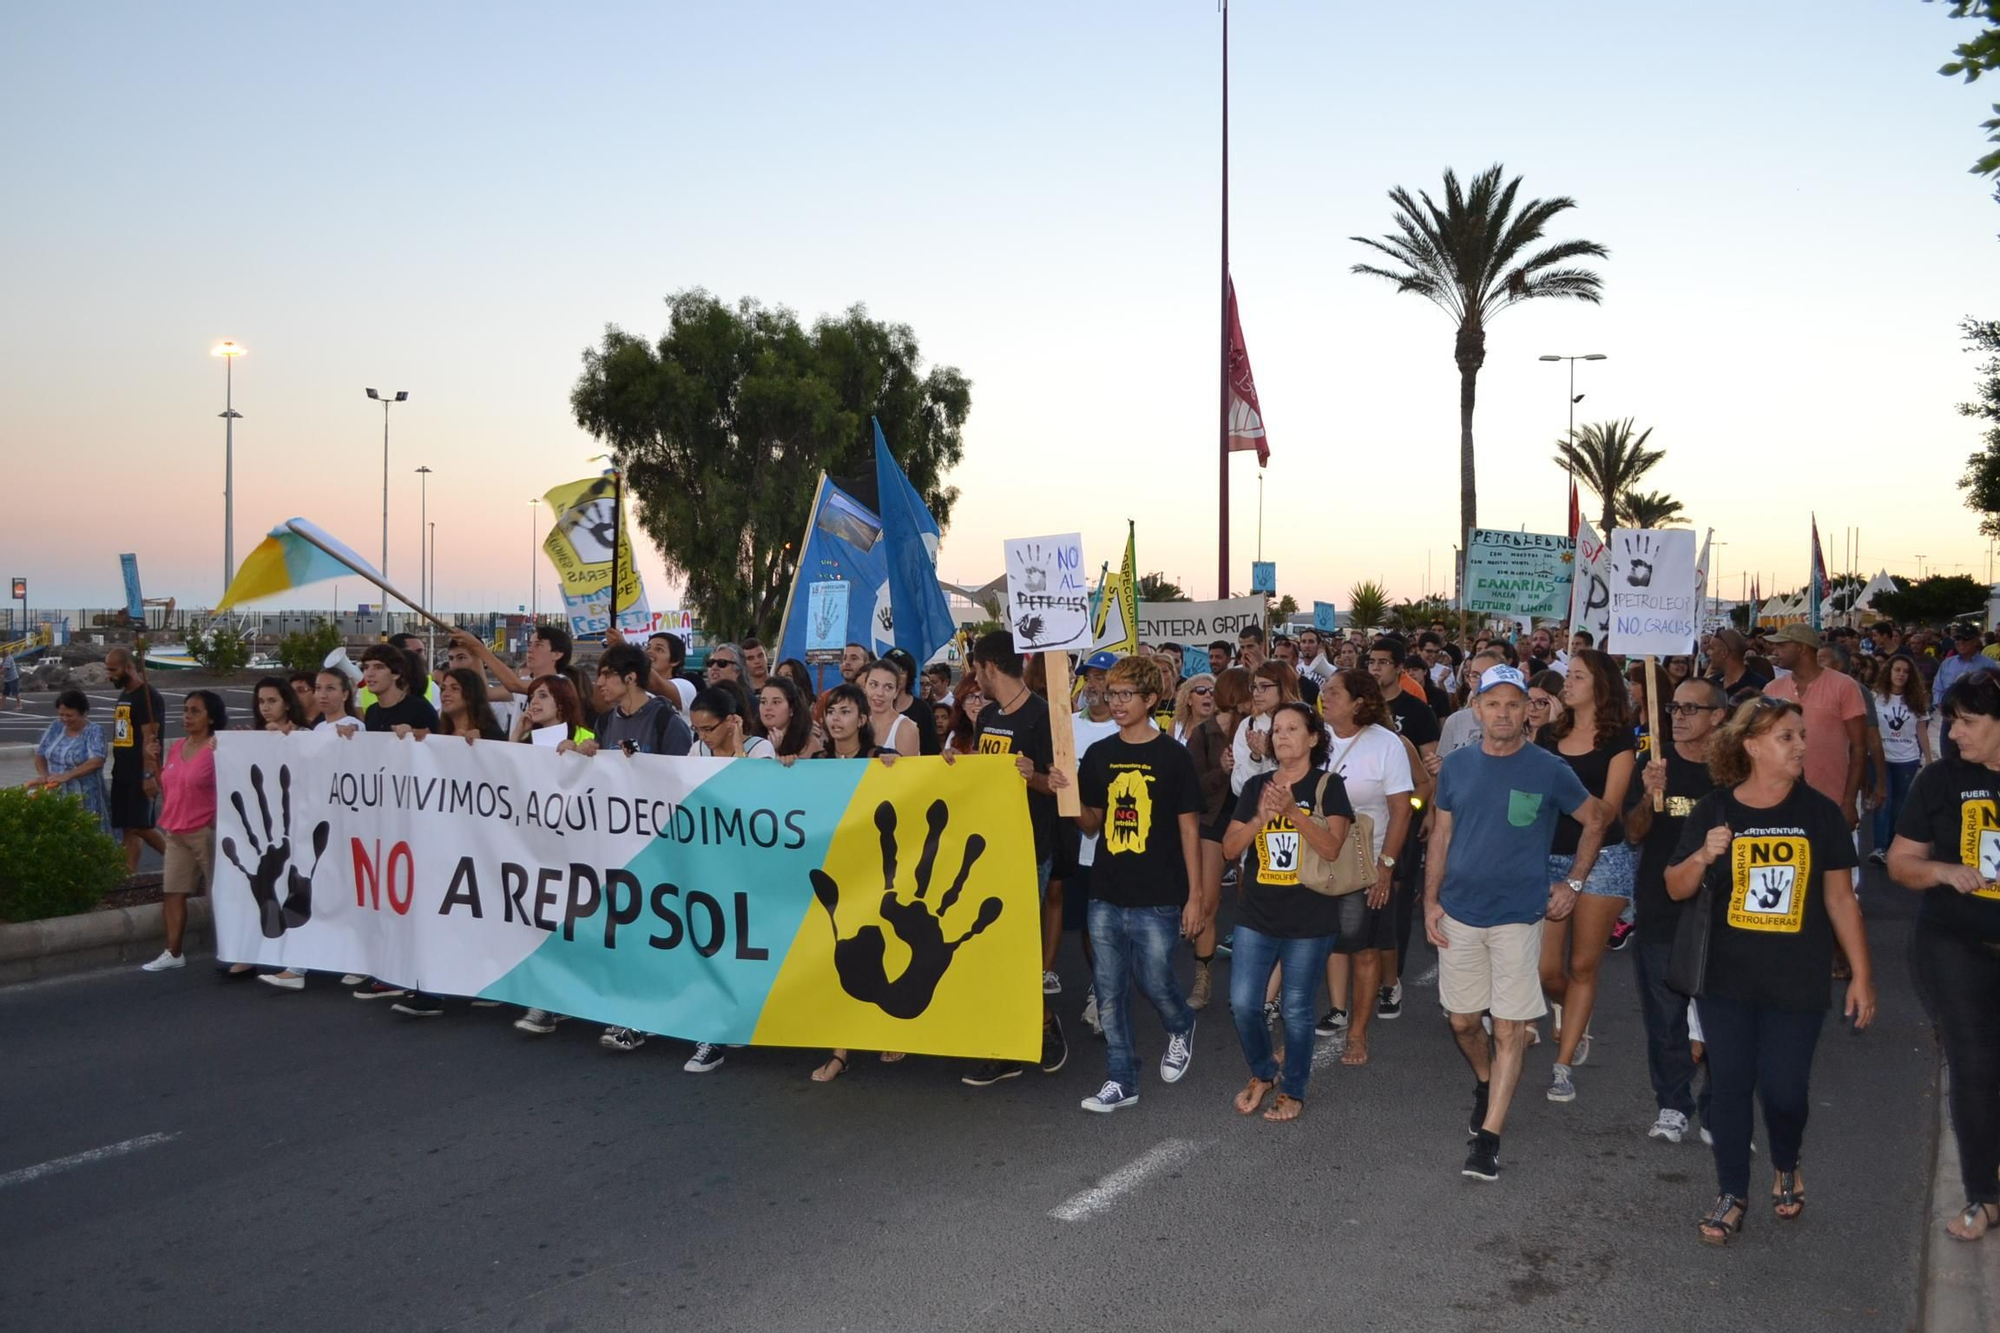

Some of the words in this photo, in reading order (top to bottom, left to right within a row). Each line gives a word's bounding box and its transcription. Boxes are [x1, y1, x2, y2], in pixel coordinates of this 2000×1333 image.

[1057, 545, 1079, 571] NO
[1060, 573, 1084, 593] AL
[1477, 578, 1556, 593] CANARIAS
[1471, 600, 1511, 612] FUTURO
[1521, 603, 1553, 613] LIMPIO
[981, 739, 1001, 754] NO
[328, 766, 385, 812] AQUÍ
[392, 774, 520, 826] VIVIMOS,
[526, 788, 597, 836] AQUÍ
[608, 796, 806, 850] DECIDIMOS
[1116, 810, 1137, 820] NO
[1750, 842, 1794, 864] NO
[1733, 898, 1741, 911] EN
[1738, 843, 1746, 894] CANARIAS
[1792, 843, 1806, 916] PROSPECCIONES
[351, 836, 415, 916] NO
[438, 856, 483, 919] A
[501, 862, 769, 961] REPPSOL
[1731, 914, 1798, 926] PETROLÍFERAS
